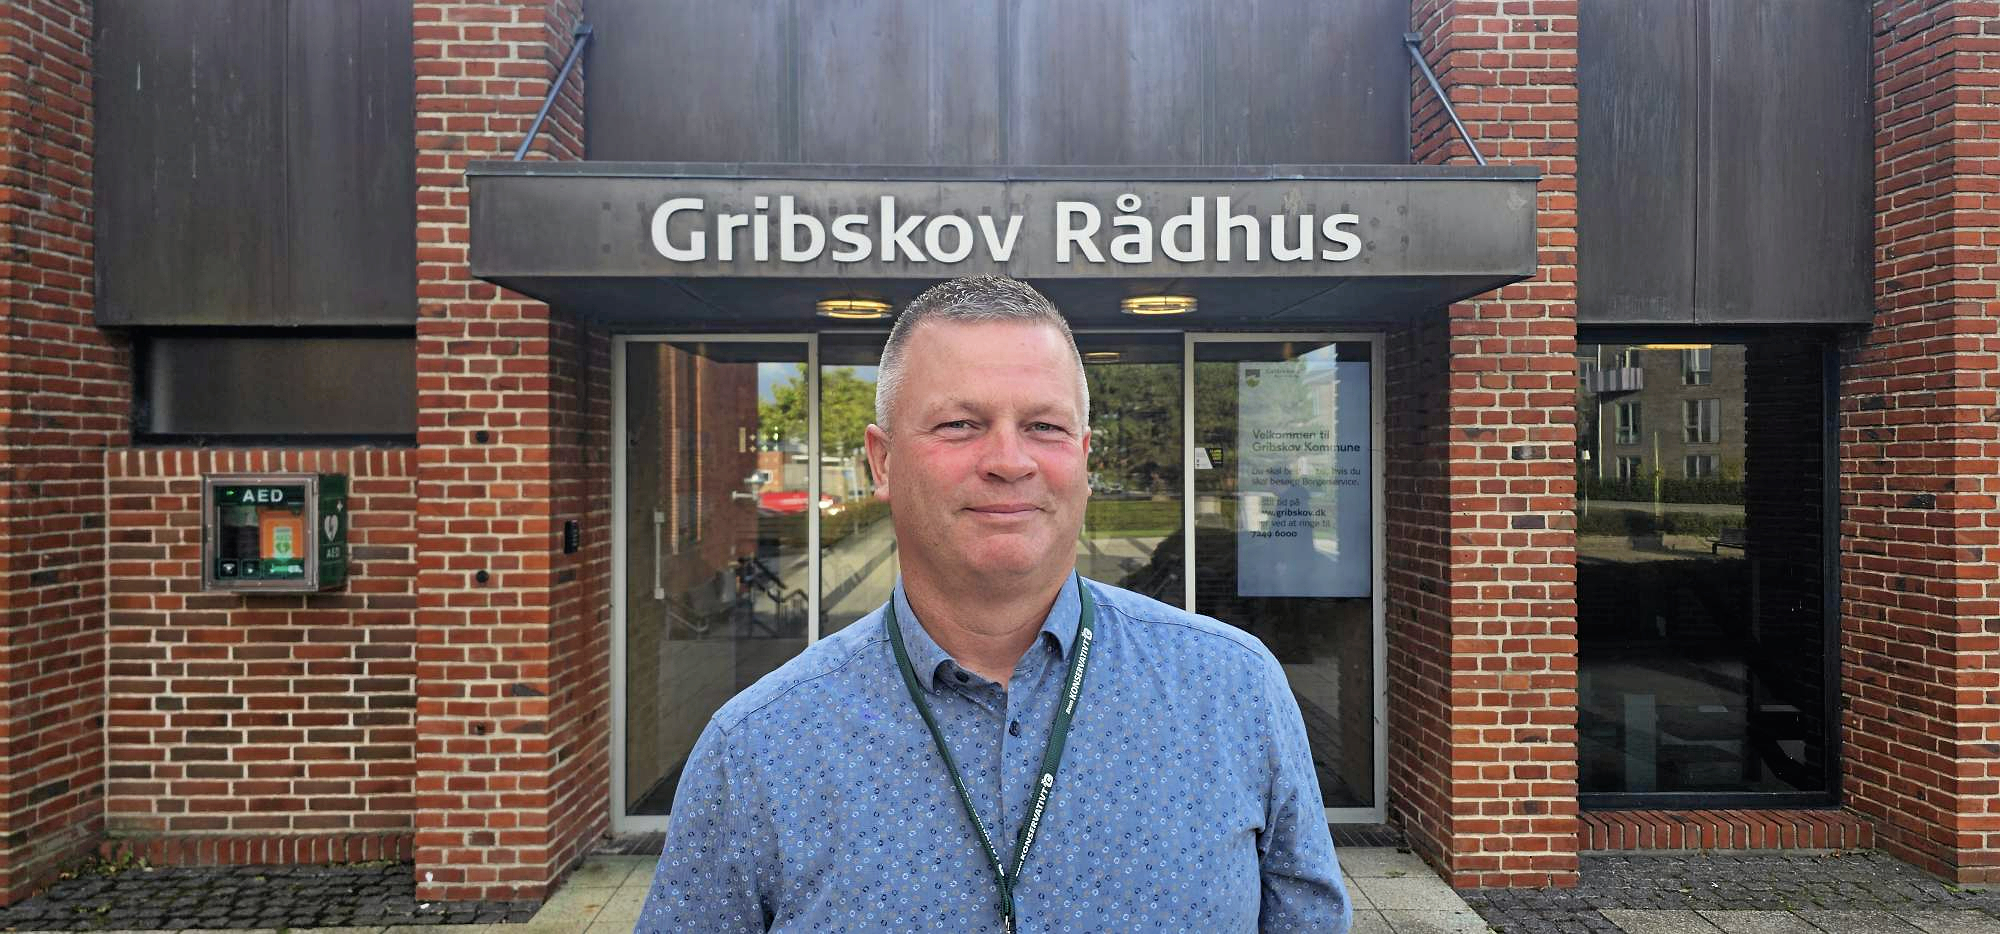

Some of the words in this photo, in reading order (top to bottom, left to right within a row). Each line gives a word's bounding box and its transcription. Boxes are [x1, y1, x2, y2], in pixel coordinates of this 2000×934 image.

[650, 195, 1024, 264] Gribskov
[1055, 193, 1363, 265] Rådhus
[1252, 429, 1316, 440] Velkommen
[1319, 429, 1330, 440] til
[1252, 441, 1301, 452] Gribskov
[242, 488, 284, 503] AED
[326, 546, 341, 559] AED
[1068, 639, 1090, 701] KONSERVATIVT
[1020, 786, 1049, 861] KONSERVATIVT
